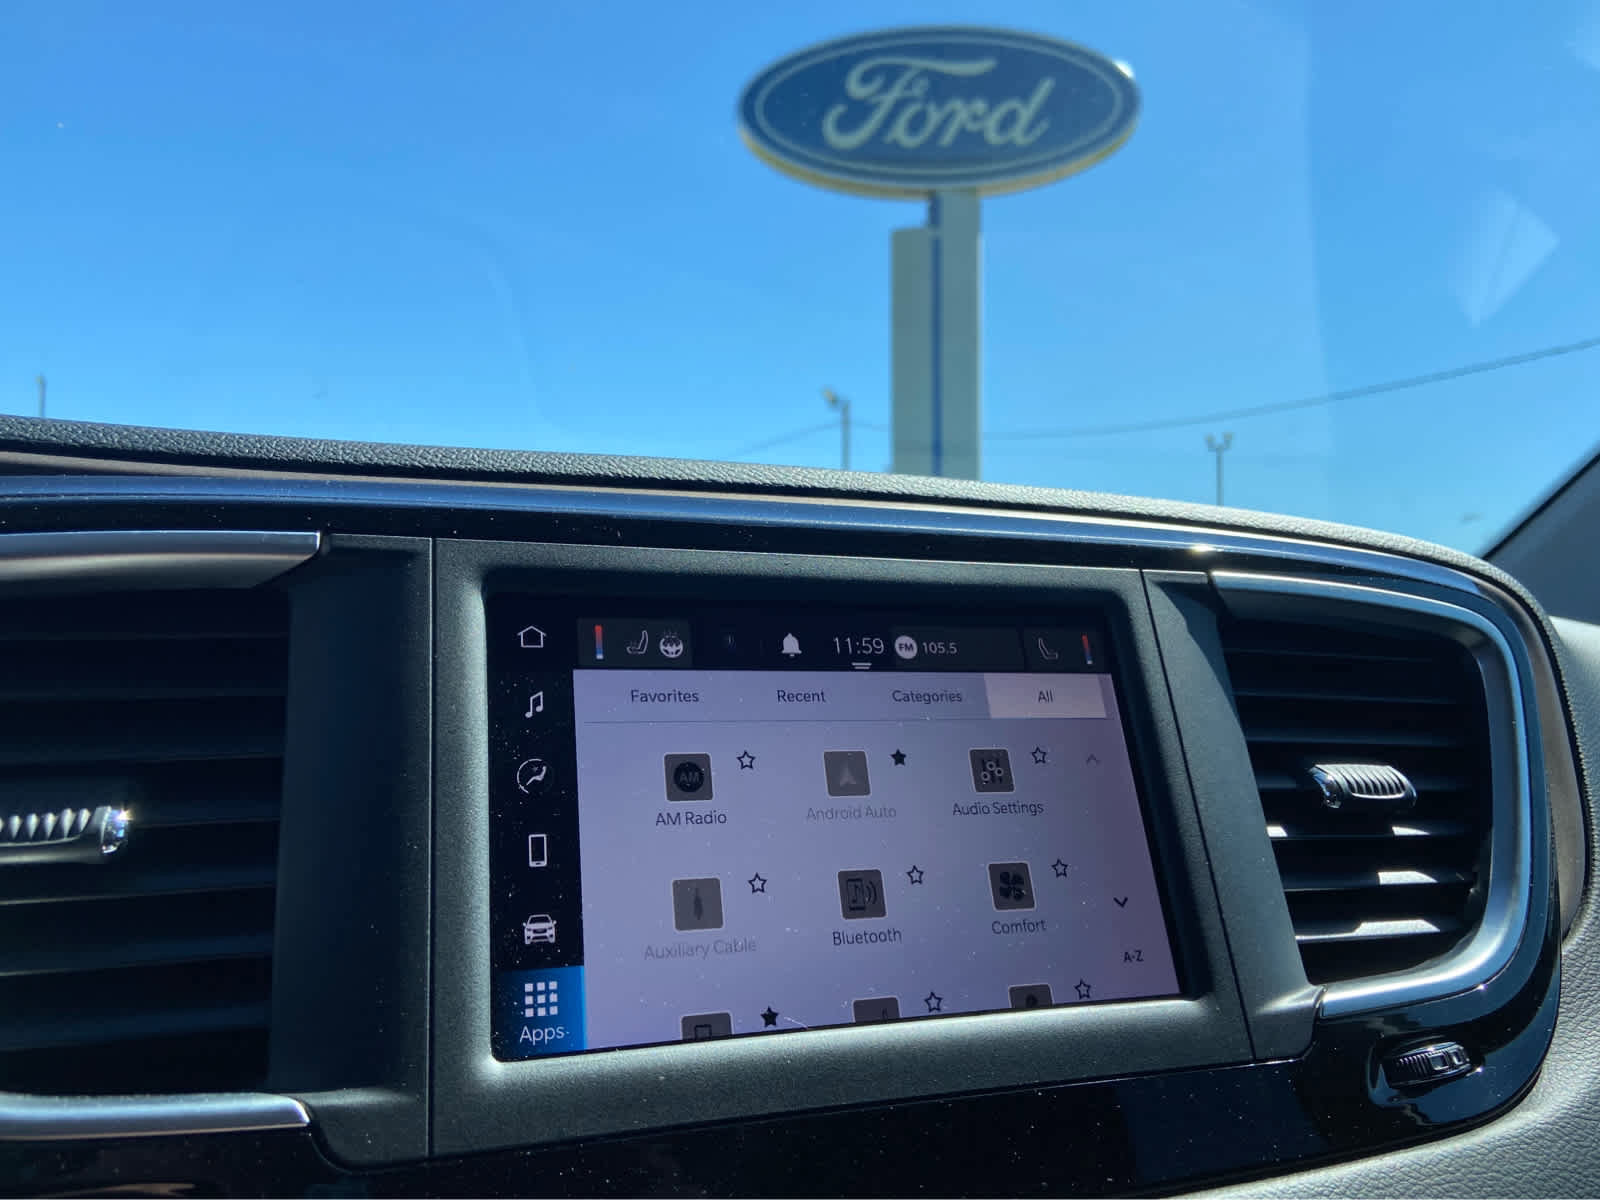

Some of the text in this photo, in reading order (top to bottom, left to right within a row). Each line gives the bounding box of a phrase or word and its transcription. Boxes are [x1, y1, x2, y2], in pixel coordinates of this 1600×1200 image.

[822, 55, 1056, 149] Ford
[832, 636, 885, 655] 11:59
[898, 641, 958, 654] FM 105.5
[630, 689, 700, 703] Favorites
[776, 689, 826, 702] Recent
[892, 689, 963, 704] Categories
[1037, 689, 1054, 702] All
[678, 772, 701, 784] AM
[805, 805, 897, 820] Android Auto
[952, 800, 1044, 817] Audio Settings
[655, 809, 728, 826] AM Radio
[991, 918, 1047, 935] Comfort
[832, 928, 902, 946] Bluetooth
[643, 938, 757, 960] Auxiliary Cable
[1123, 950, 1144, 963] A-Z
[519, 1025, 566, 1043] Apps
